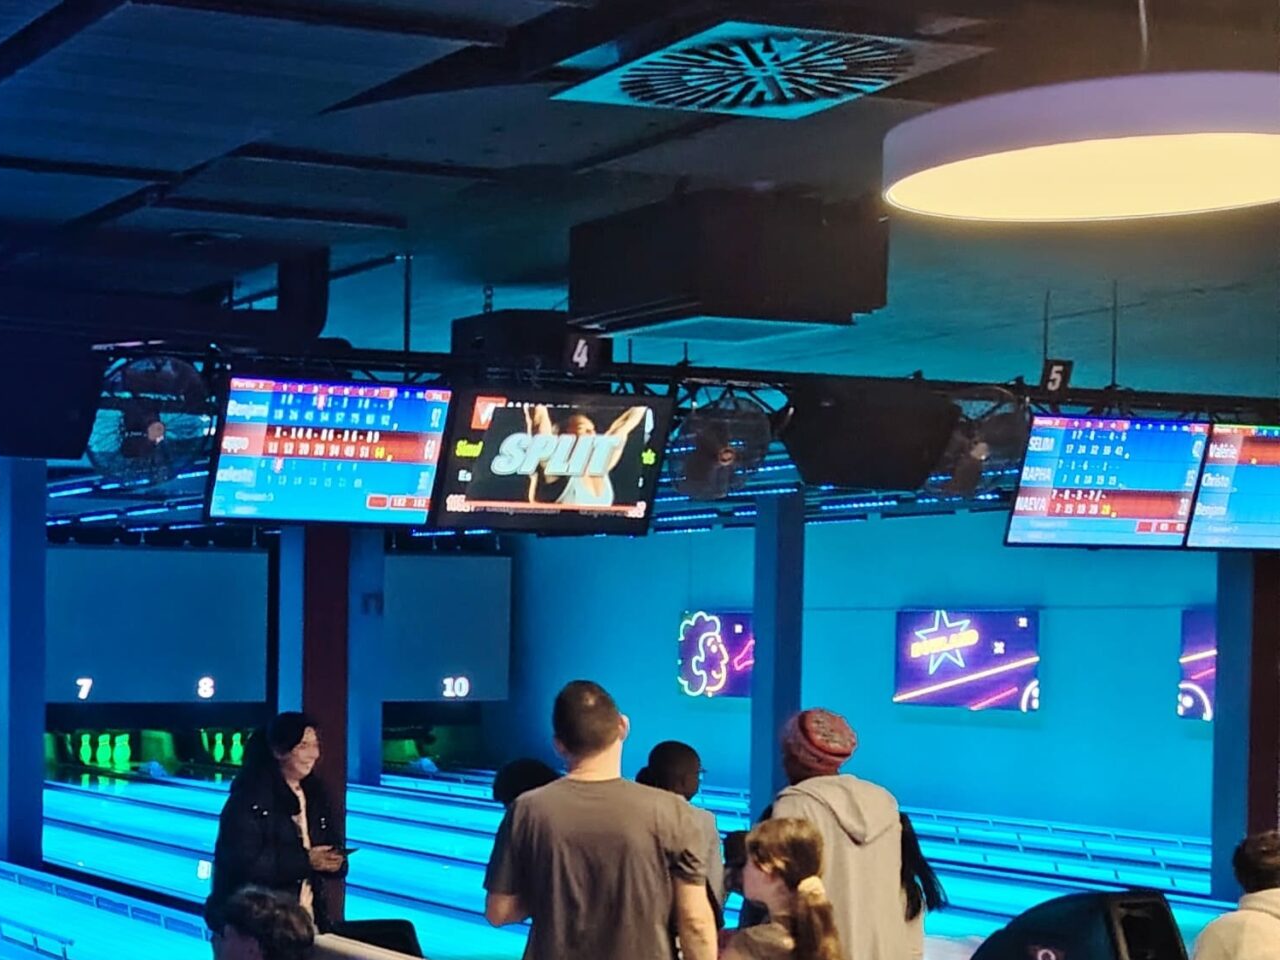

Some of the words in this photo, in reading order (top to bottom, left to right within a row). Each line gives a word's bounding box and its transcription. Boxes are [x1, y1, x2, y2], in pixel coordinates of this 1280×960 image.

[573, 339, 588, 368] 4
[1047, 365, 1063, 391] 5
[490, 432, 619, 475] SPLIT
[76, 678, 93, 700] 7
[197, 676, 214, 699] 8
[442, 676, 469, 697] 10
